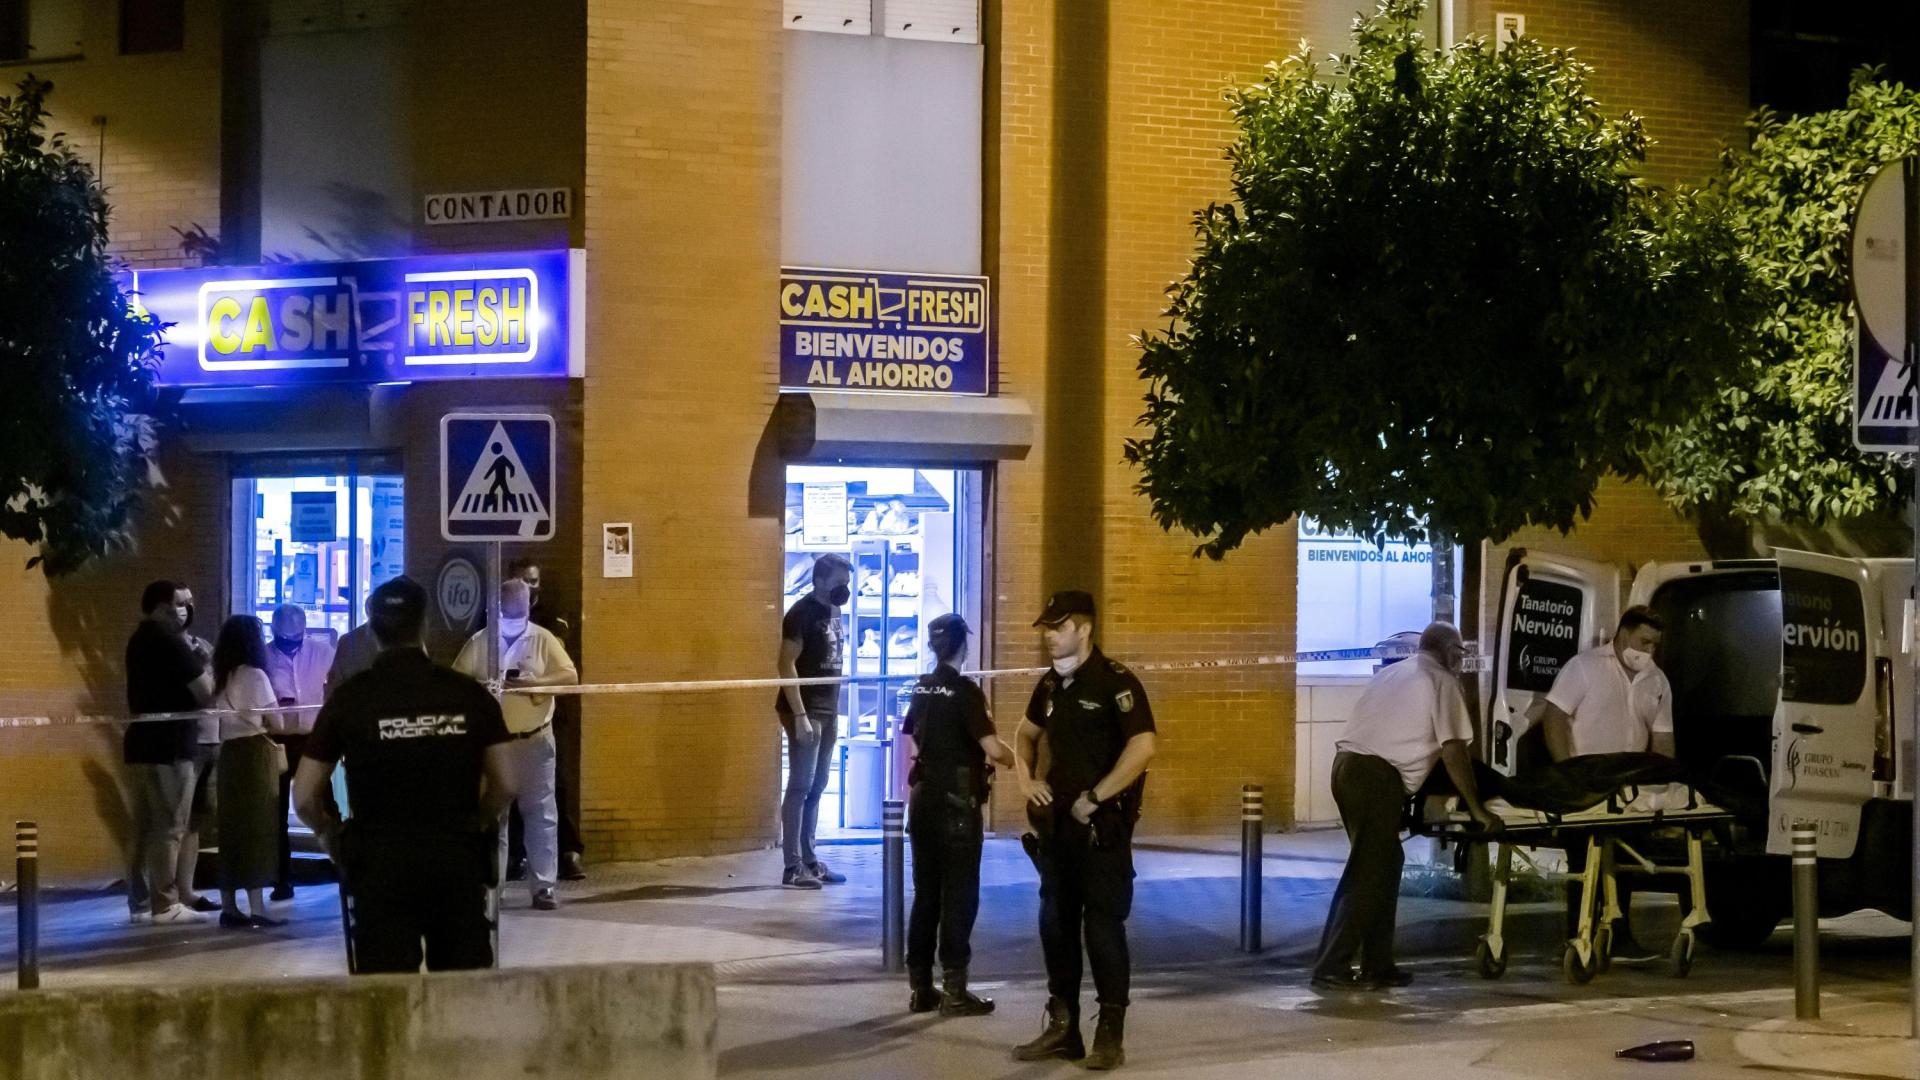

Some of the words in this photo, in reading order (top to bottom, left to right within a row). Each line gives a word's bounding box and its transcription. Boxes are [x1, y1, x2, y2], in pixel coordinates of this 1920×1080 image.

[427, 191, 566, 220] CONTADOR
[781, 283, 873, 319] CASH
[908, 289, 979, 324] FRESH
[208, 293, 349, 355] CASH
[408, 287, 526, 348] FRESH
[795, 331, 964, 362] BIENVENIDOS
[807, 360, 841, 385] AL
[846, 362, 953, 389] AHORRO
[1308, 550, 1383, 562] BIENVENIDOS
[1385, 551, 1398, 563] AL
[1521, 594, 1574, 616] Tanatorio
[1514, 613, 1573, 639] Nervión
[1783, 617, 1859, 652] ervión
[1533, 656, 1557, 665] GRUPO
[1804, 753, 1833, 764] GRUPO
